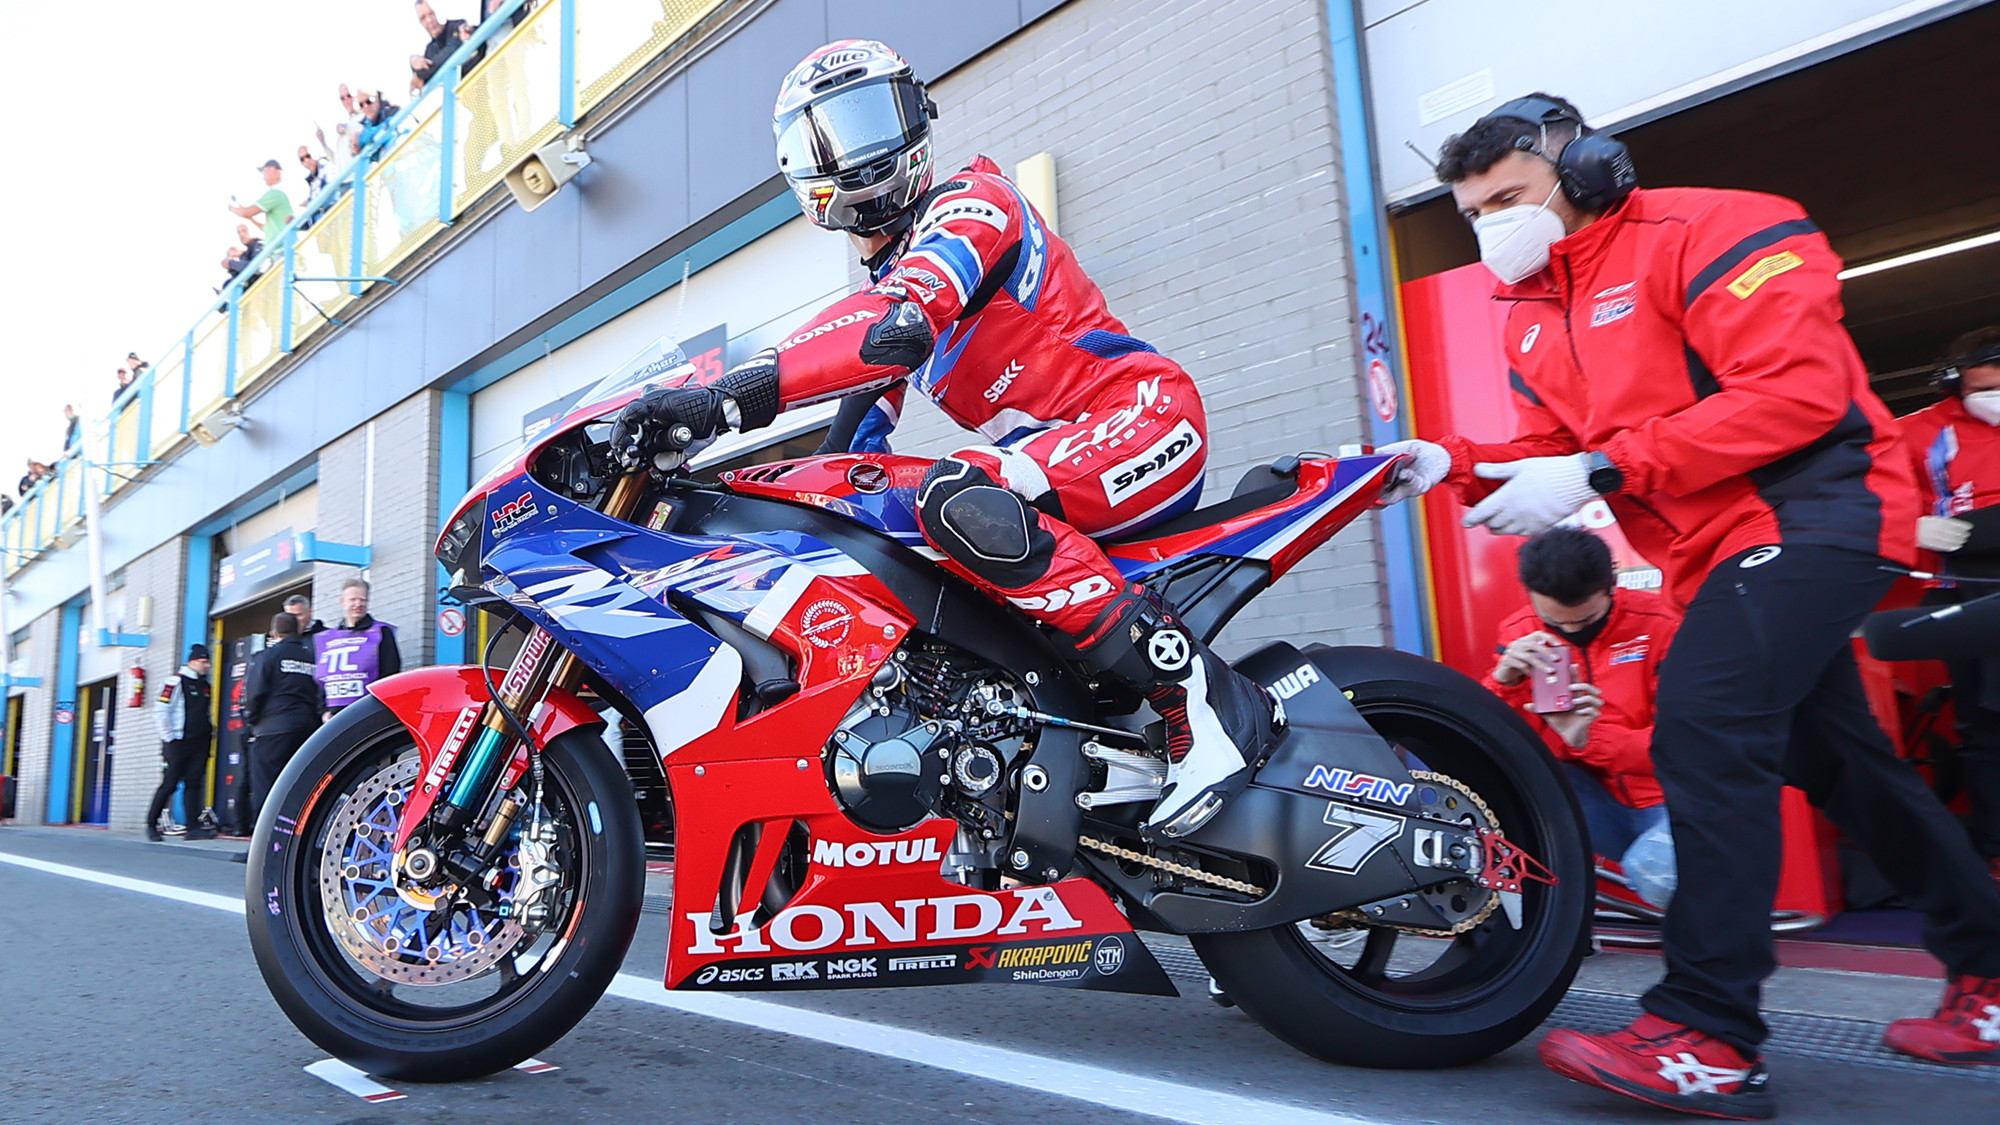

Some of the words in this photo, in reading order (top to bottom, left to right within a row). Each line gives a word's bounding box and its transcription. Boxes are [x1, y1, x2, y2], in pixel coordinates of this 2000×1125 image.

[777, 308, 879, 352] HONDA
[1112, 432, 1195, 495] SPIDI
[491, 491, 538, 529] HRC
[510, 627, 552, 695] SHOWA
[424, 707, 478, 788] PIRELLI
[812, 836, 942, 868] MOTUL
[1305, 801, 1407, 875] 7
[686, 886, 1083, 955] HONDA
[771, 961, 819, 977] RK
[827, 957, 878, 975] NGK
[889, 954, 957, 971] PIRELLI
[998, 940, 1092, 968] AKRAPOVIČ
[1097, 949, 1122, 964] STM
[718, 967, 765, 983] asics
[827, 973, 851, 981] SPARK
[853, 971, 878, 979] PLUGS
[1013, 969, 1079, 981] ShinDengen
